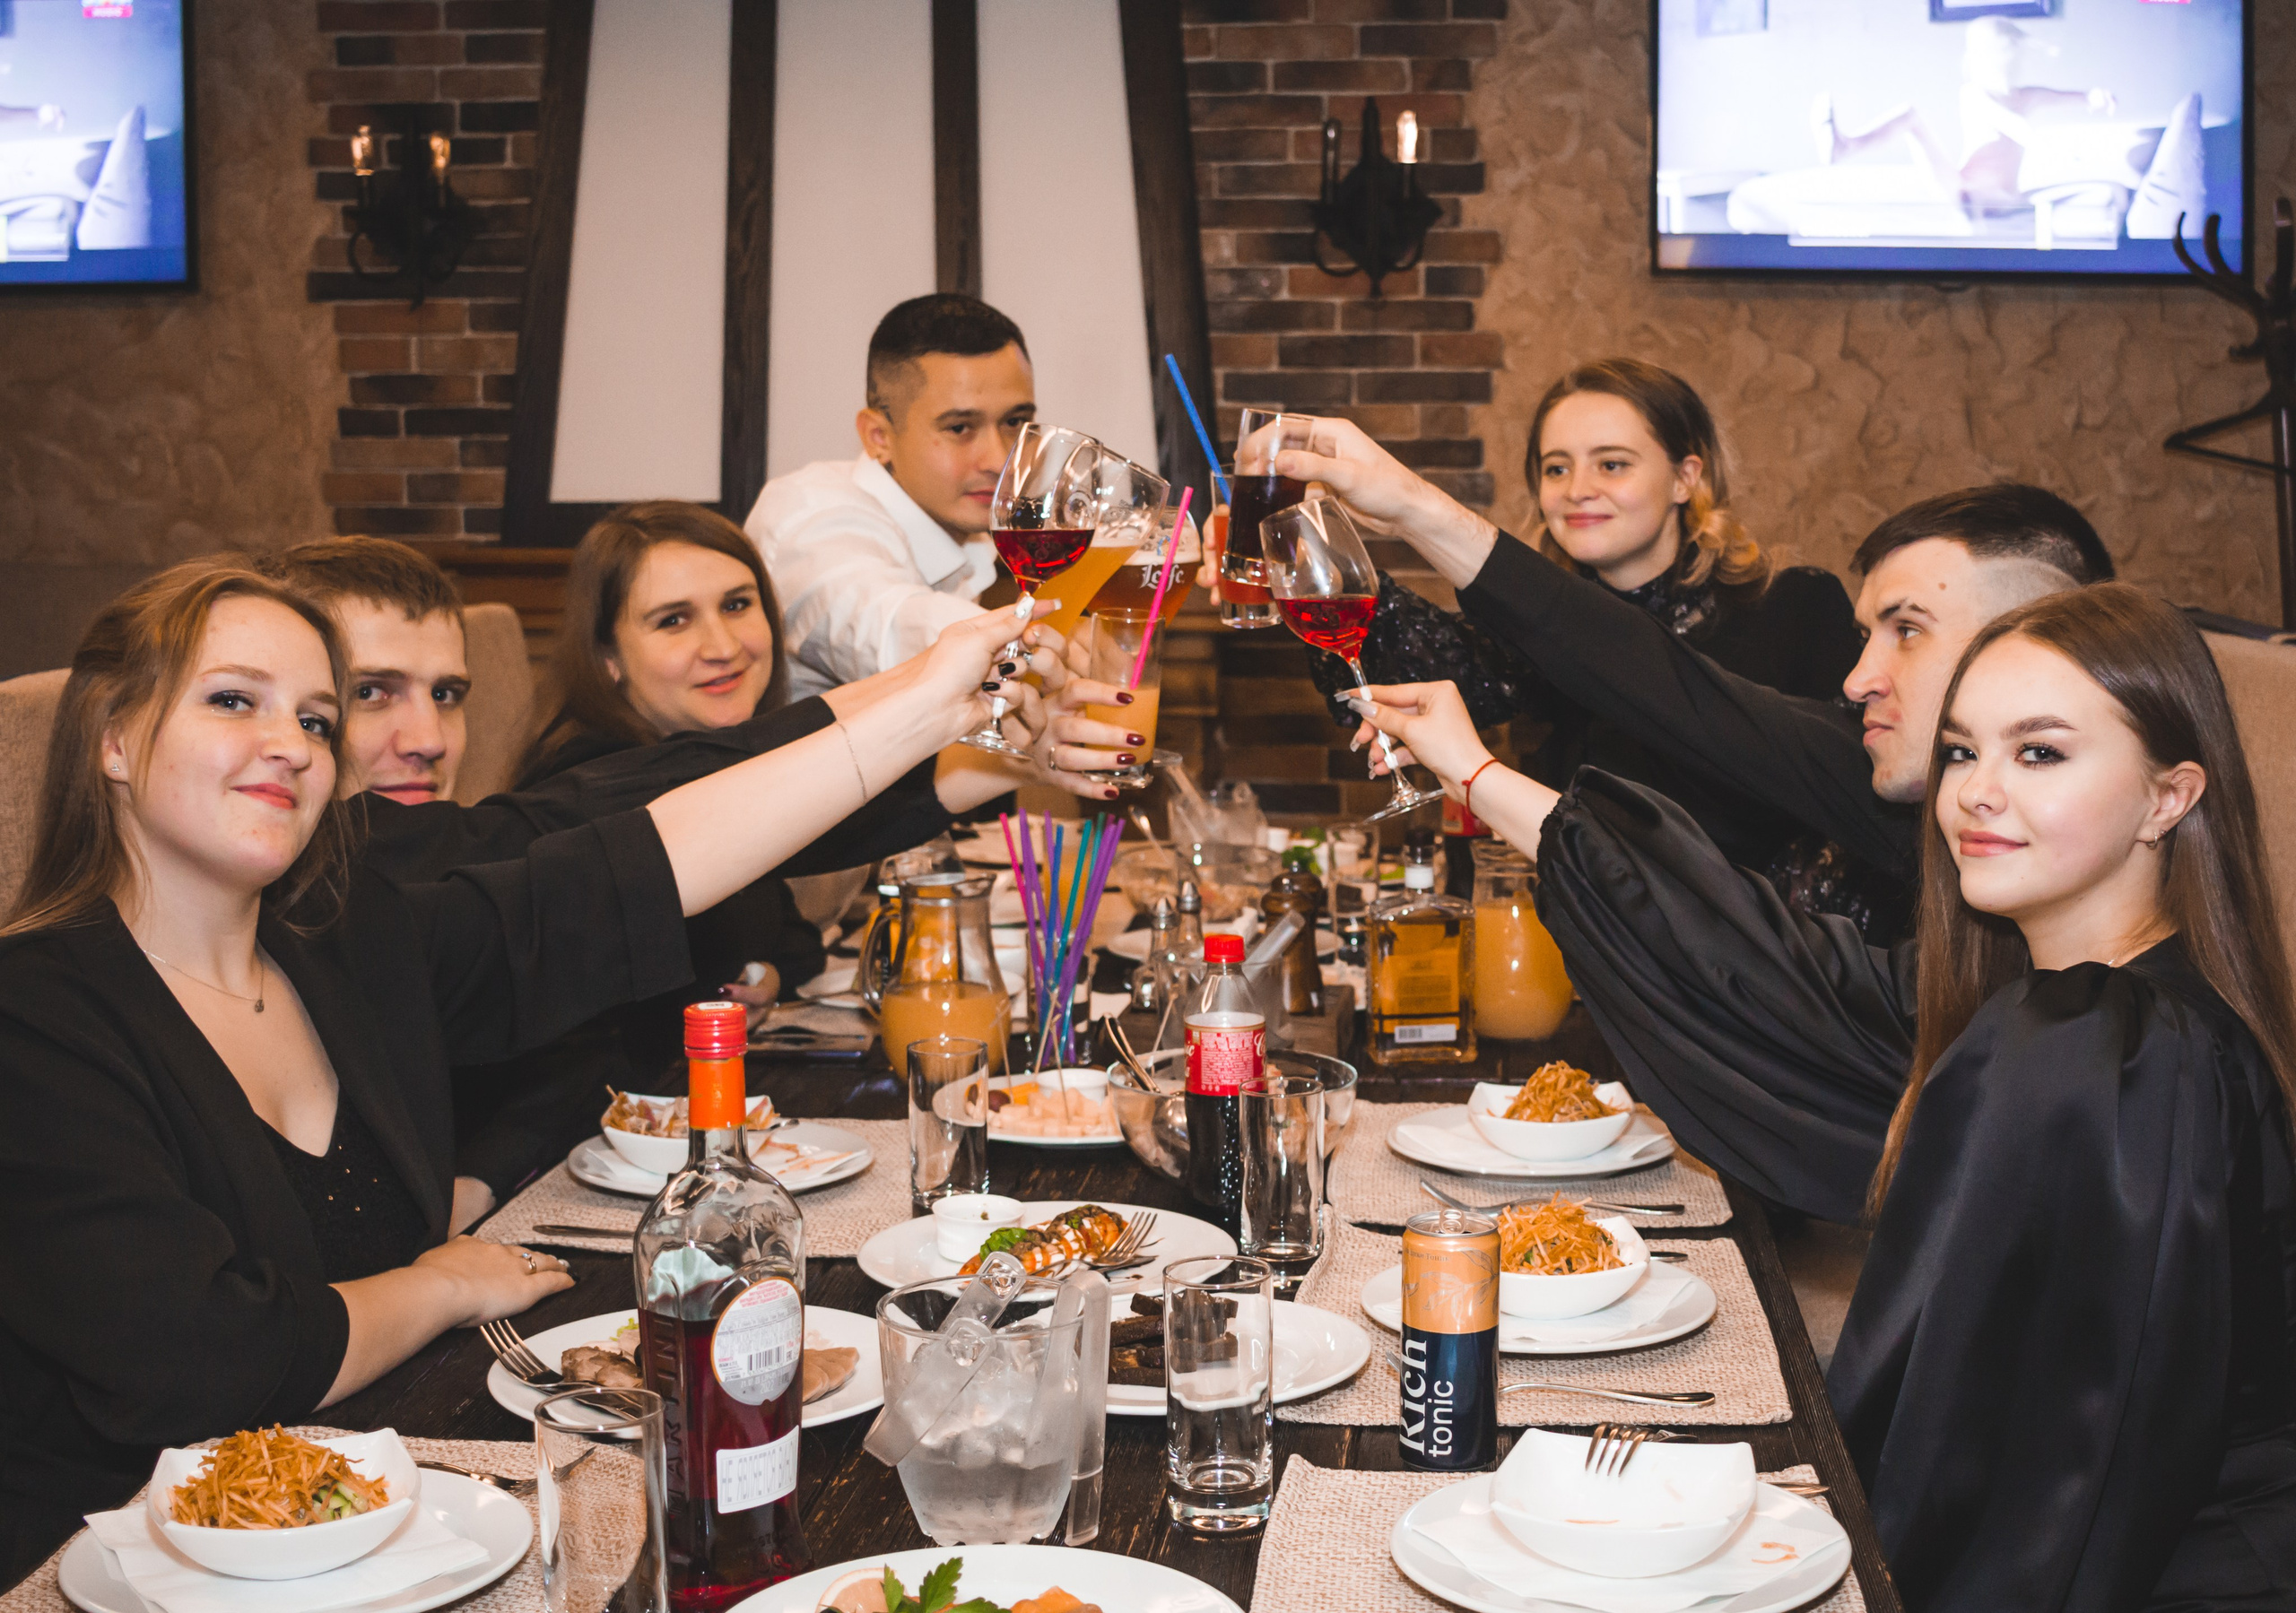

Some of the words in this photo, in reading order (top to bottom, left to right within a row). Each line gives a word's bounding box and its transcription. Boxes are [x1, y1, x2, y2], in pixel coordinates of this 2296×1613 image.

[1139, 562, 1185, 592] Lefe
[1399, 1340, 1427, 1455] Rich
[1428, 1380, 1454, 1458] tonic
